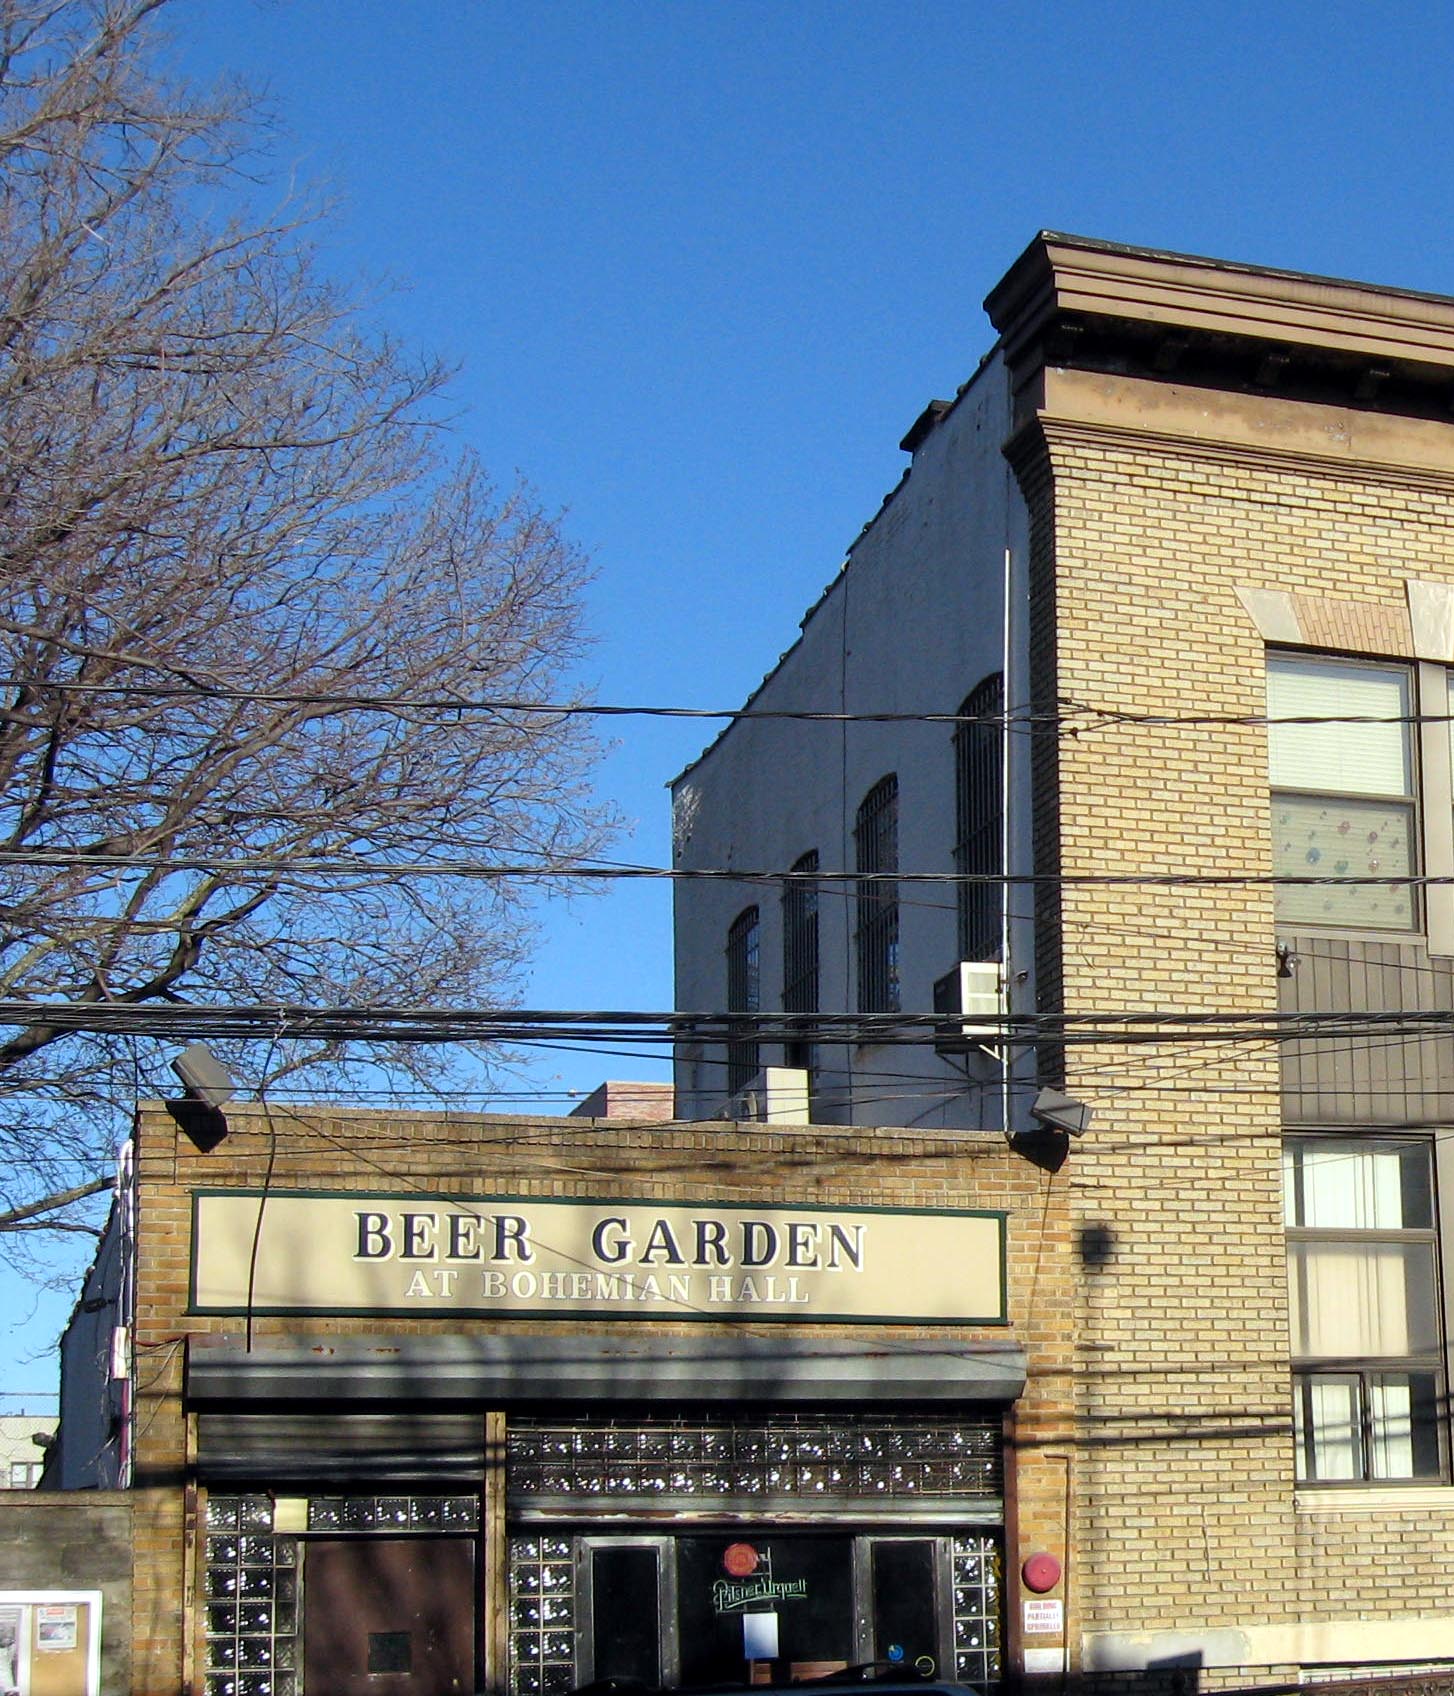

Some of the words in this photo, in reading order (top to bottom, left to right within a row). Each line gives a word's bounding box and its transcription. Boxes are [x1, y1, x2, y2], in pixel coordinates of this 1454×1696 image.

[353, 1211, 537, 1266] BEER
[591, 1217, 867, 1273] GARDEN
[405, 1269, 458, 1299] AT
[482, 1271, 690, 1301] BOHEMIAN
[709, 1274, 809, 1303] HALL
[713, 1579, 760, 1611] Pilsner
[761, 1577, 807, 1601] Urquell
